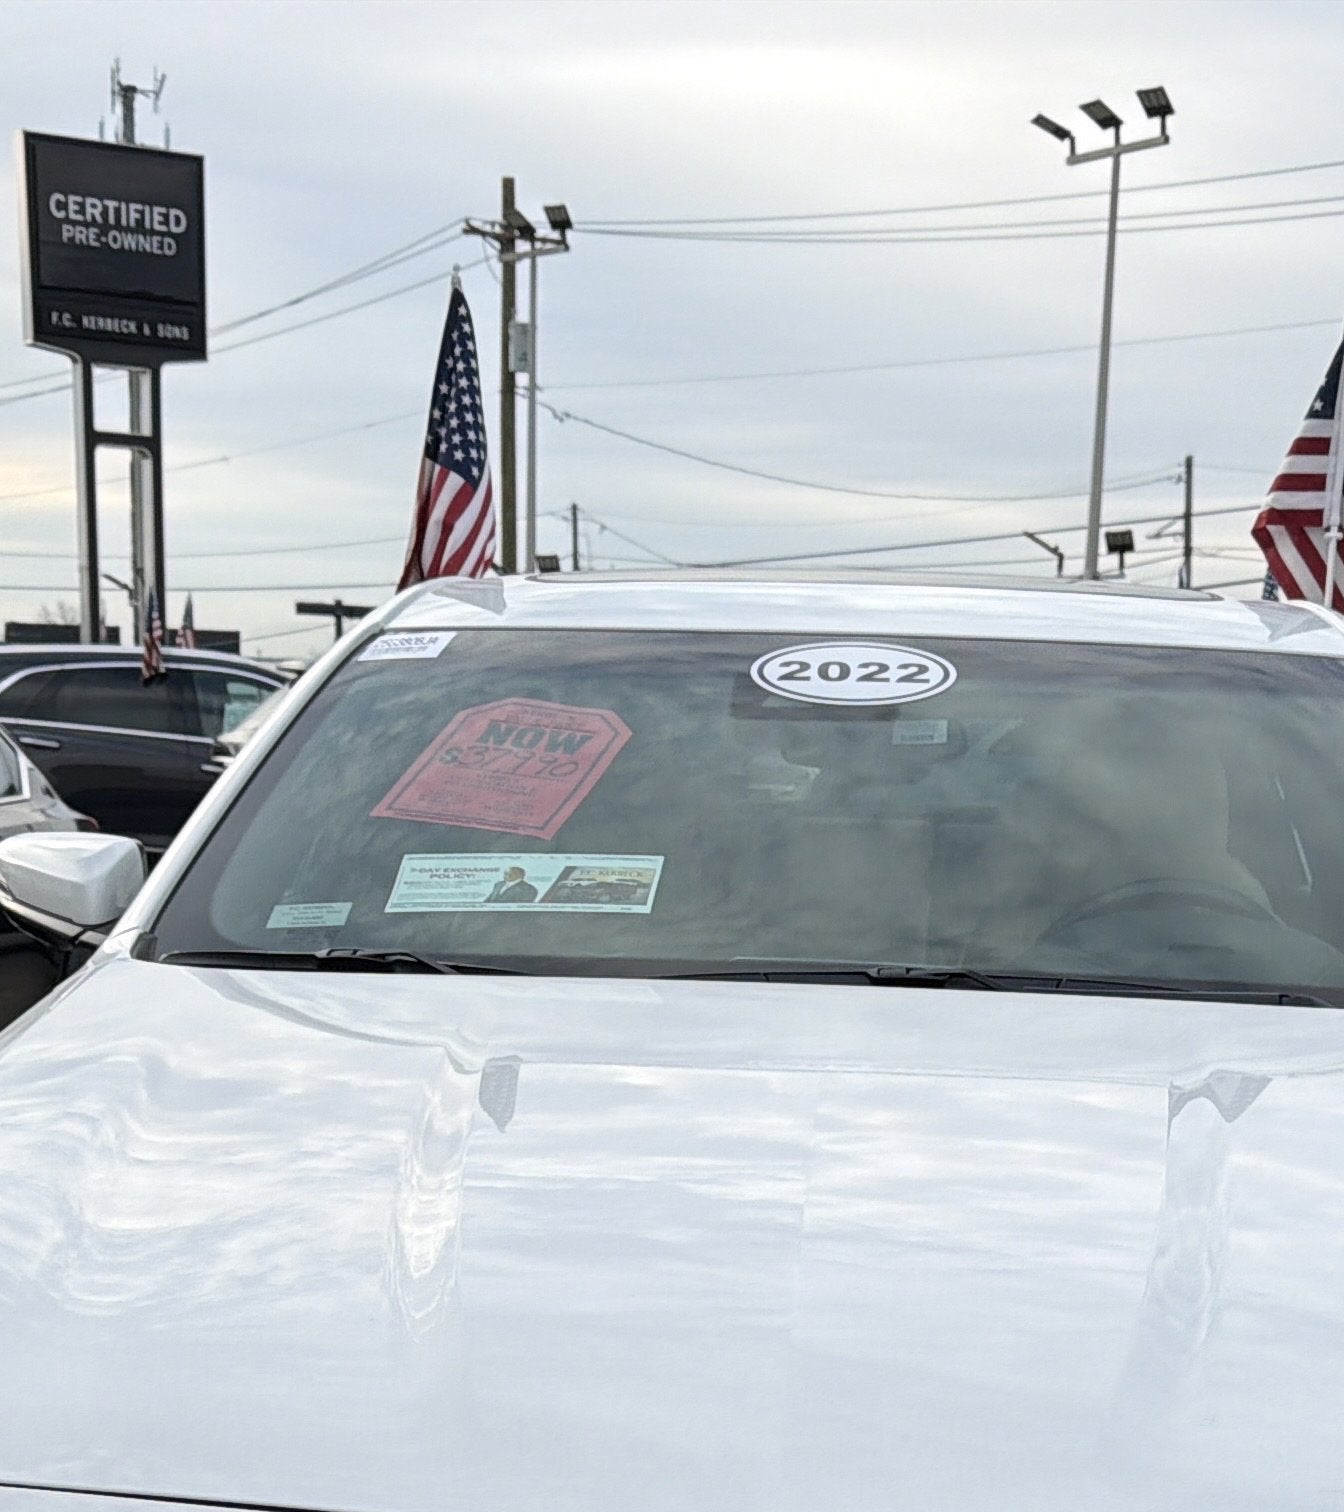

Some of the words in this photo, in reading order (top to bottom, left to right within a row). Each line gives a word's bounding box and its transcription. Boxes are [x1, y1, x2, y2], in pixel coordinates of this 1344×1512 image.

[49, 192, 187, 234] CERTIFIED
[62, 223, 177, 256] PRE-OWNED
[51, 311, 77, 328] F.C.
[82, 315, 138, 334] KERBECK
[776, 660, 931, 684] 2022
[478, 721, 593, 755] NOW
